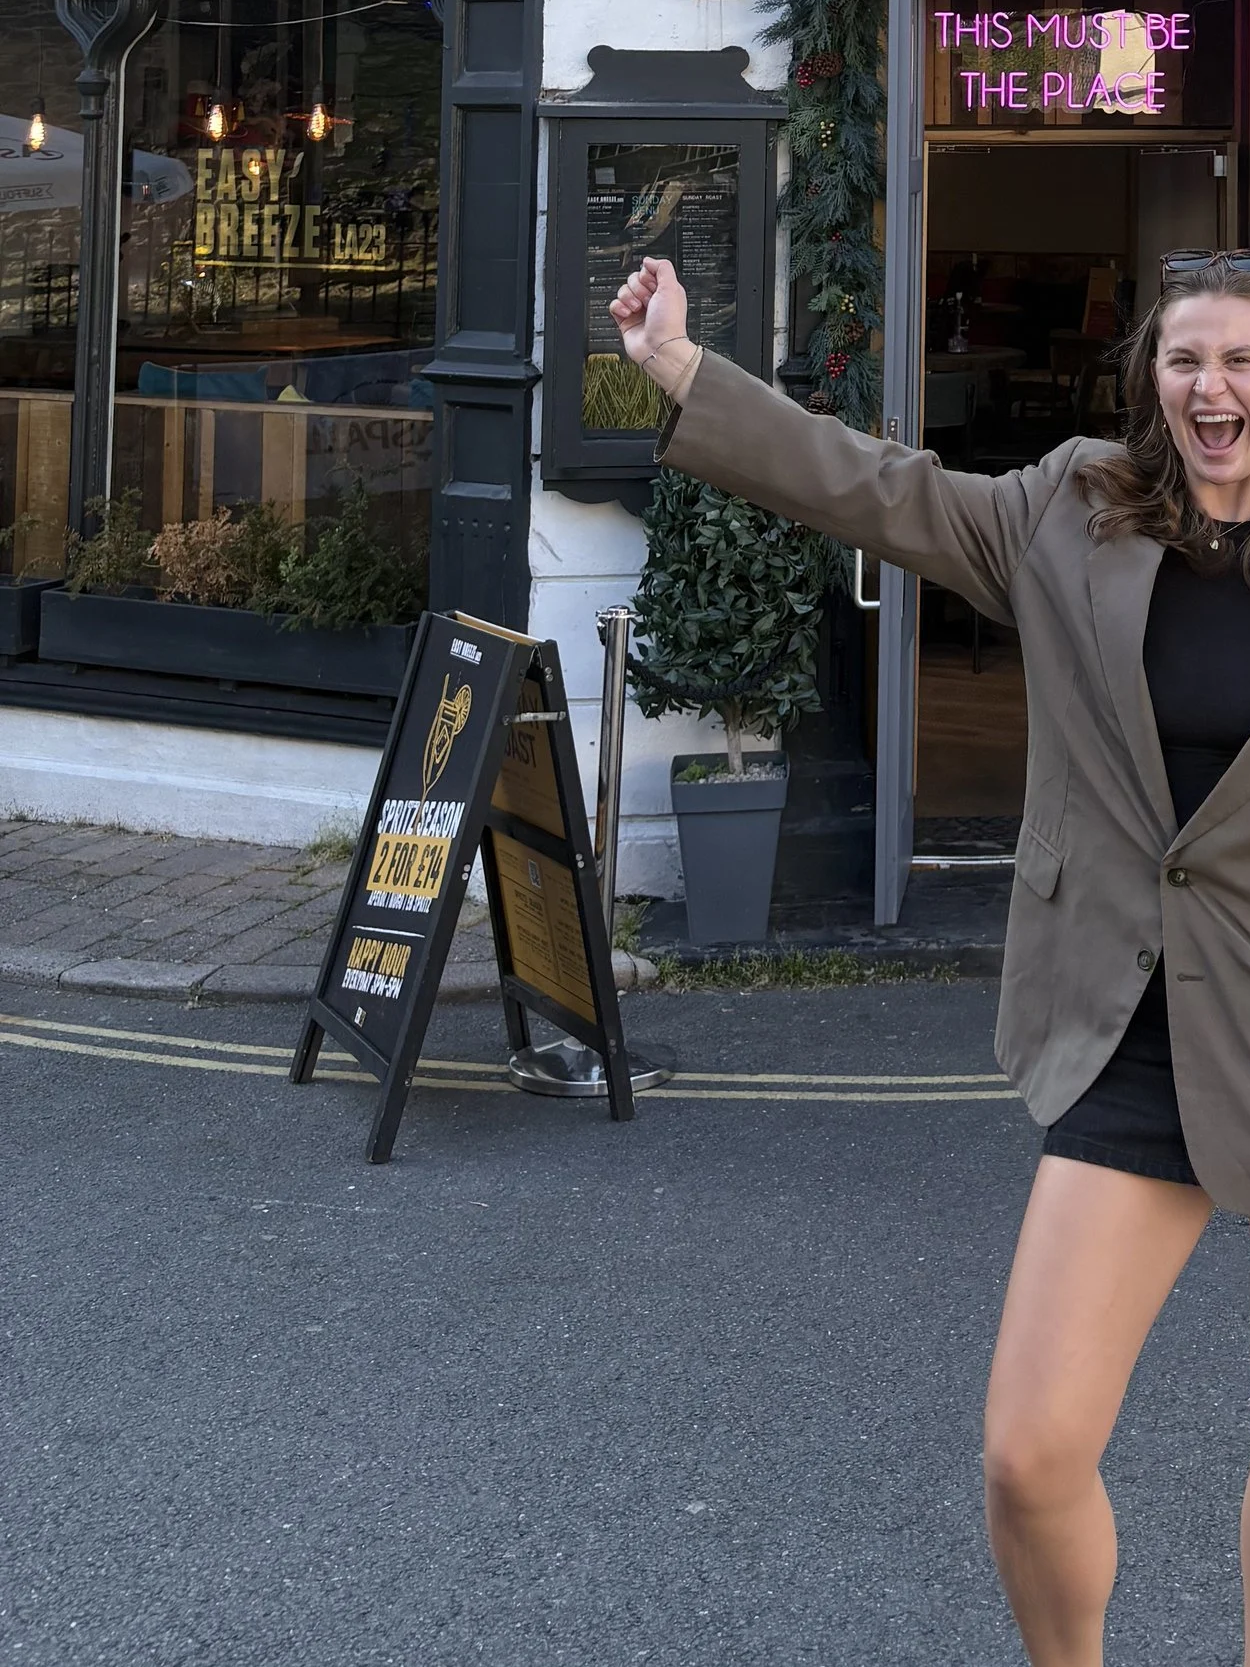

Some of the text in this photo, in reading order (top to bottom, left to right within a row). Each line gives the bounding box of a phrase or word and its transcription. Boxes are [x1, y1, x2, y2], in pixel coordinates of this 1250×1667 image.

[934, 12, 1190, 50] THIS MUST BE
[960, 72, 1166, 110] THE PLACE
[197, 148, 286, 201] EASY
[195, 204, 386, 261] BREEZE LA23
[378, 799, 465, 838] SPRITZ SEASON
[373, 841, 443, 889] 2 FOR £14
[347, 937, 411, 978] HAPPY HOUR
